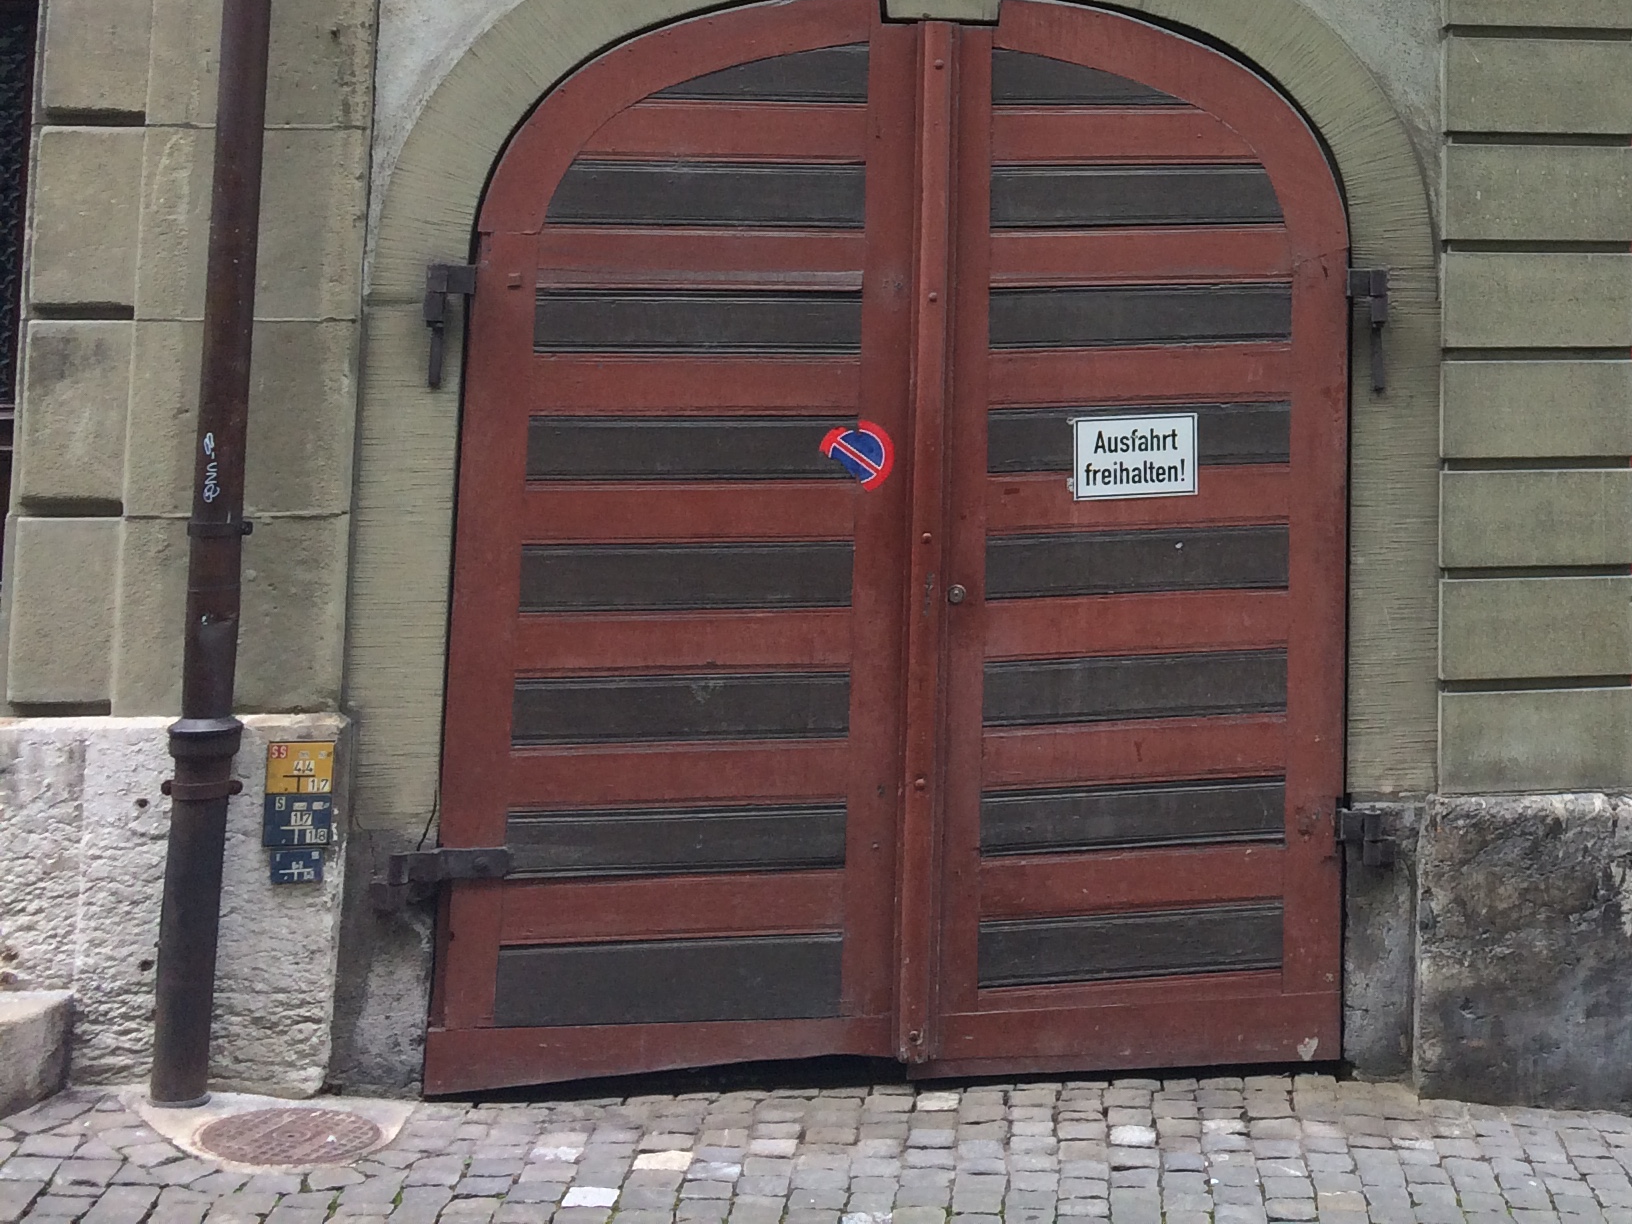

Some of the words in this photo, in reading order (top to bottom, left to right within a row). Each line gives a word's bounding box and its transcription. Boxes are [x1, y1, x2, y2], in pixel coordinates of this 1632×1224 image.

[1093, 428, 1178, 454] Ausfahrt
[1084, 458, 1185, 486] freihalten!
[277, 797, 284, 809] S
